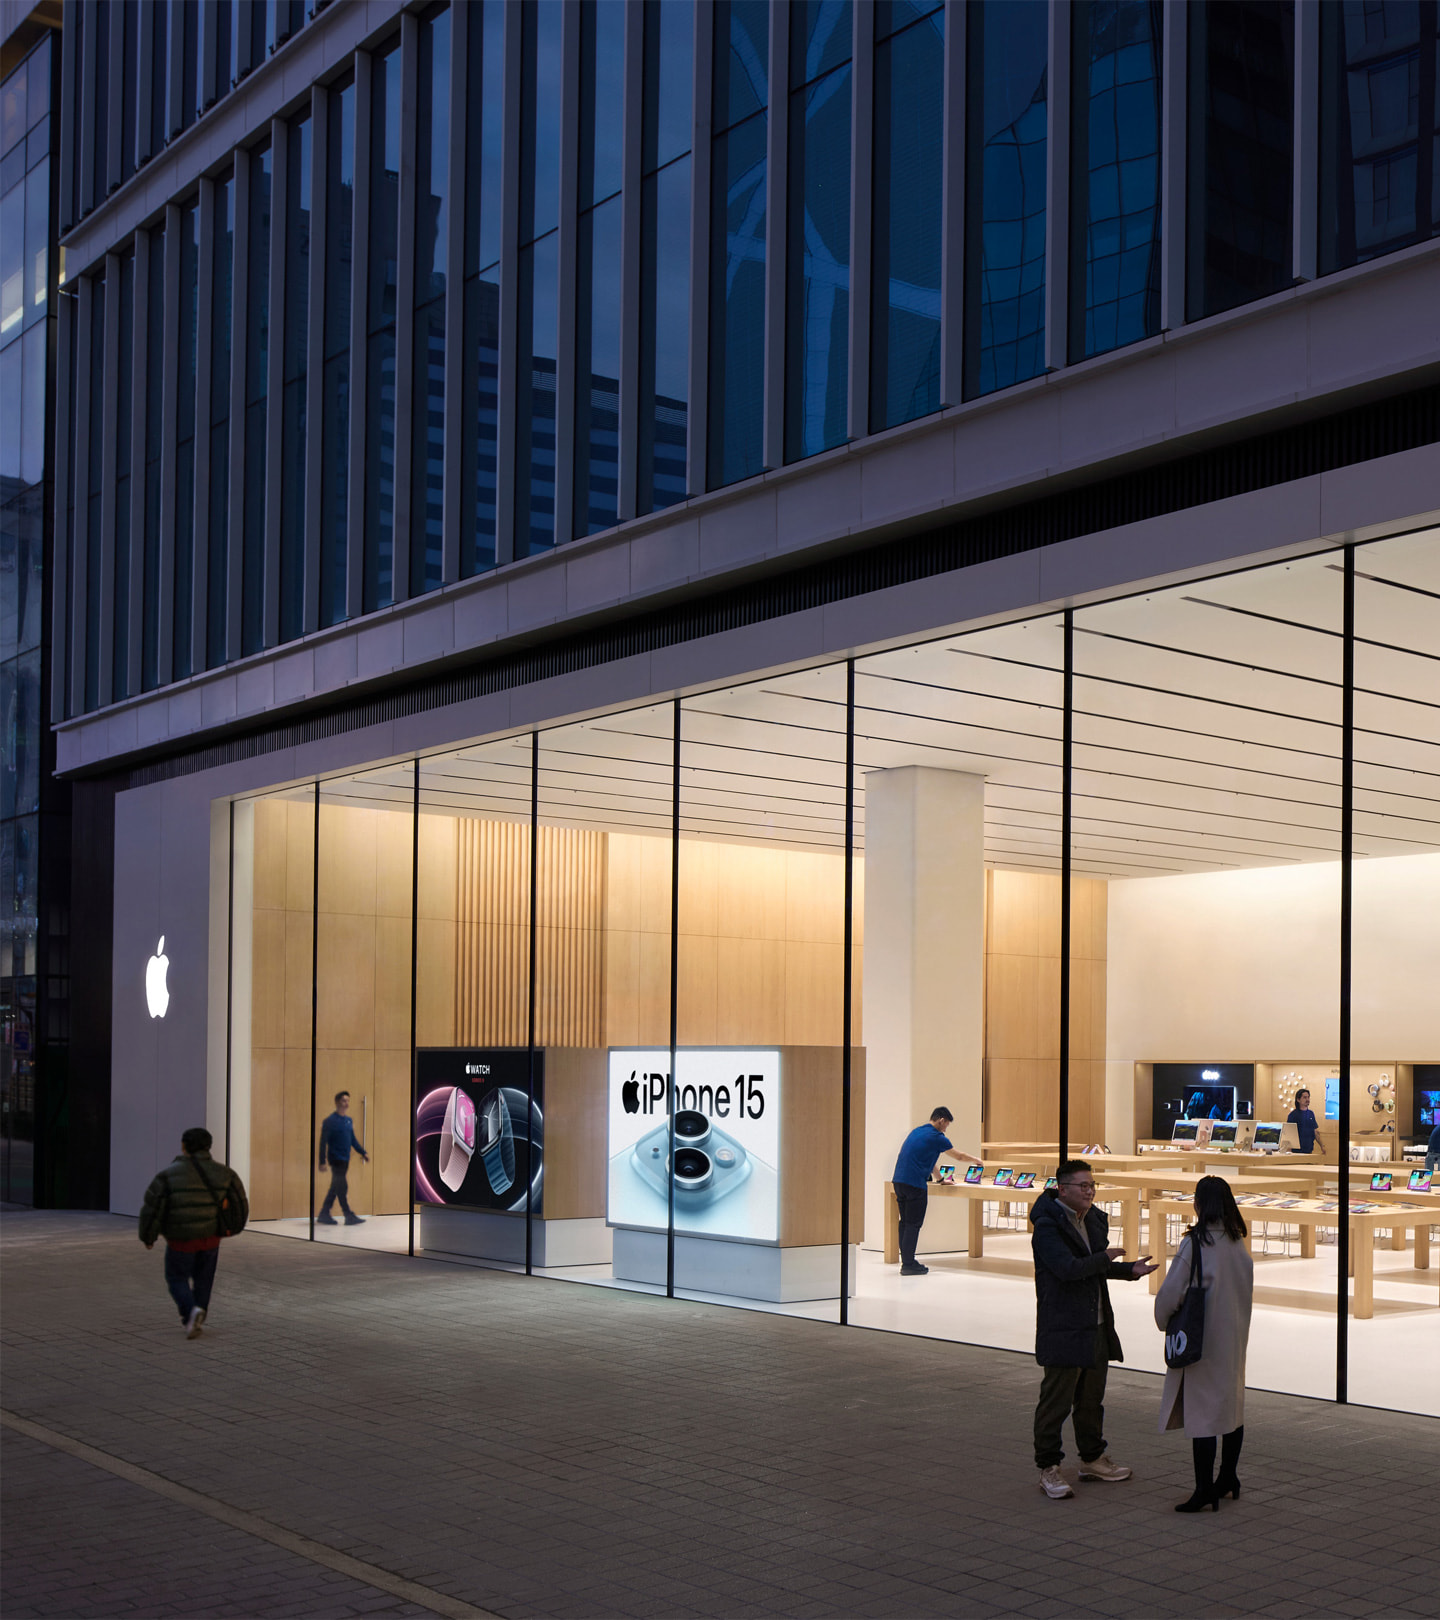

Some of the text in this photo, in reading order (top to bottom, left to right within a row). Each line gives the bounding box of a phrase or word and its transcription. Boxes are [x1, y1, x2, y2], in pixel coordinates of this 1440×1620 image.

[470, 1064, 490, 1075] WATCH
[643, 1073, 765, 1119] iPhone 15
